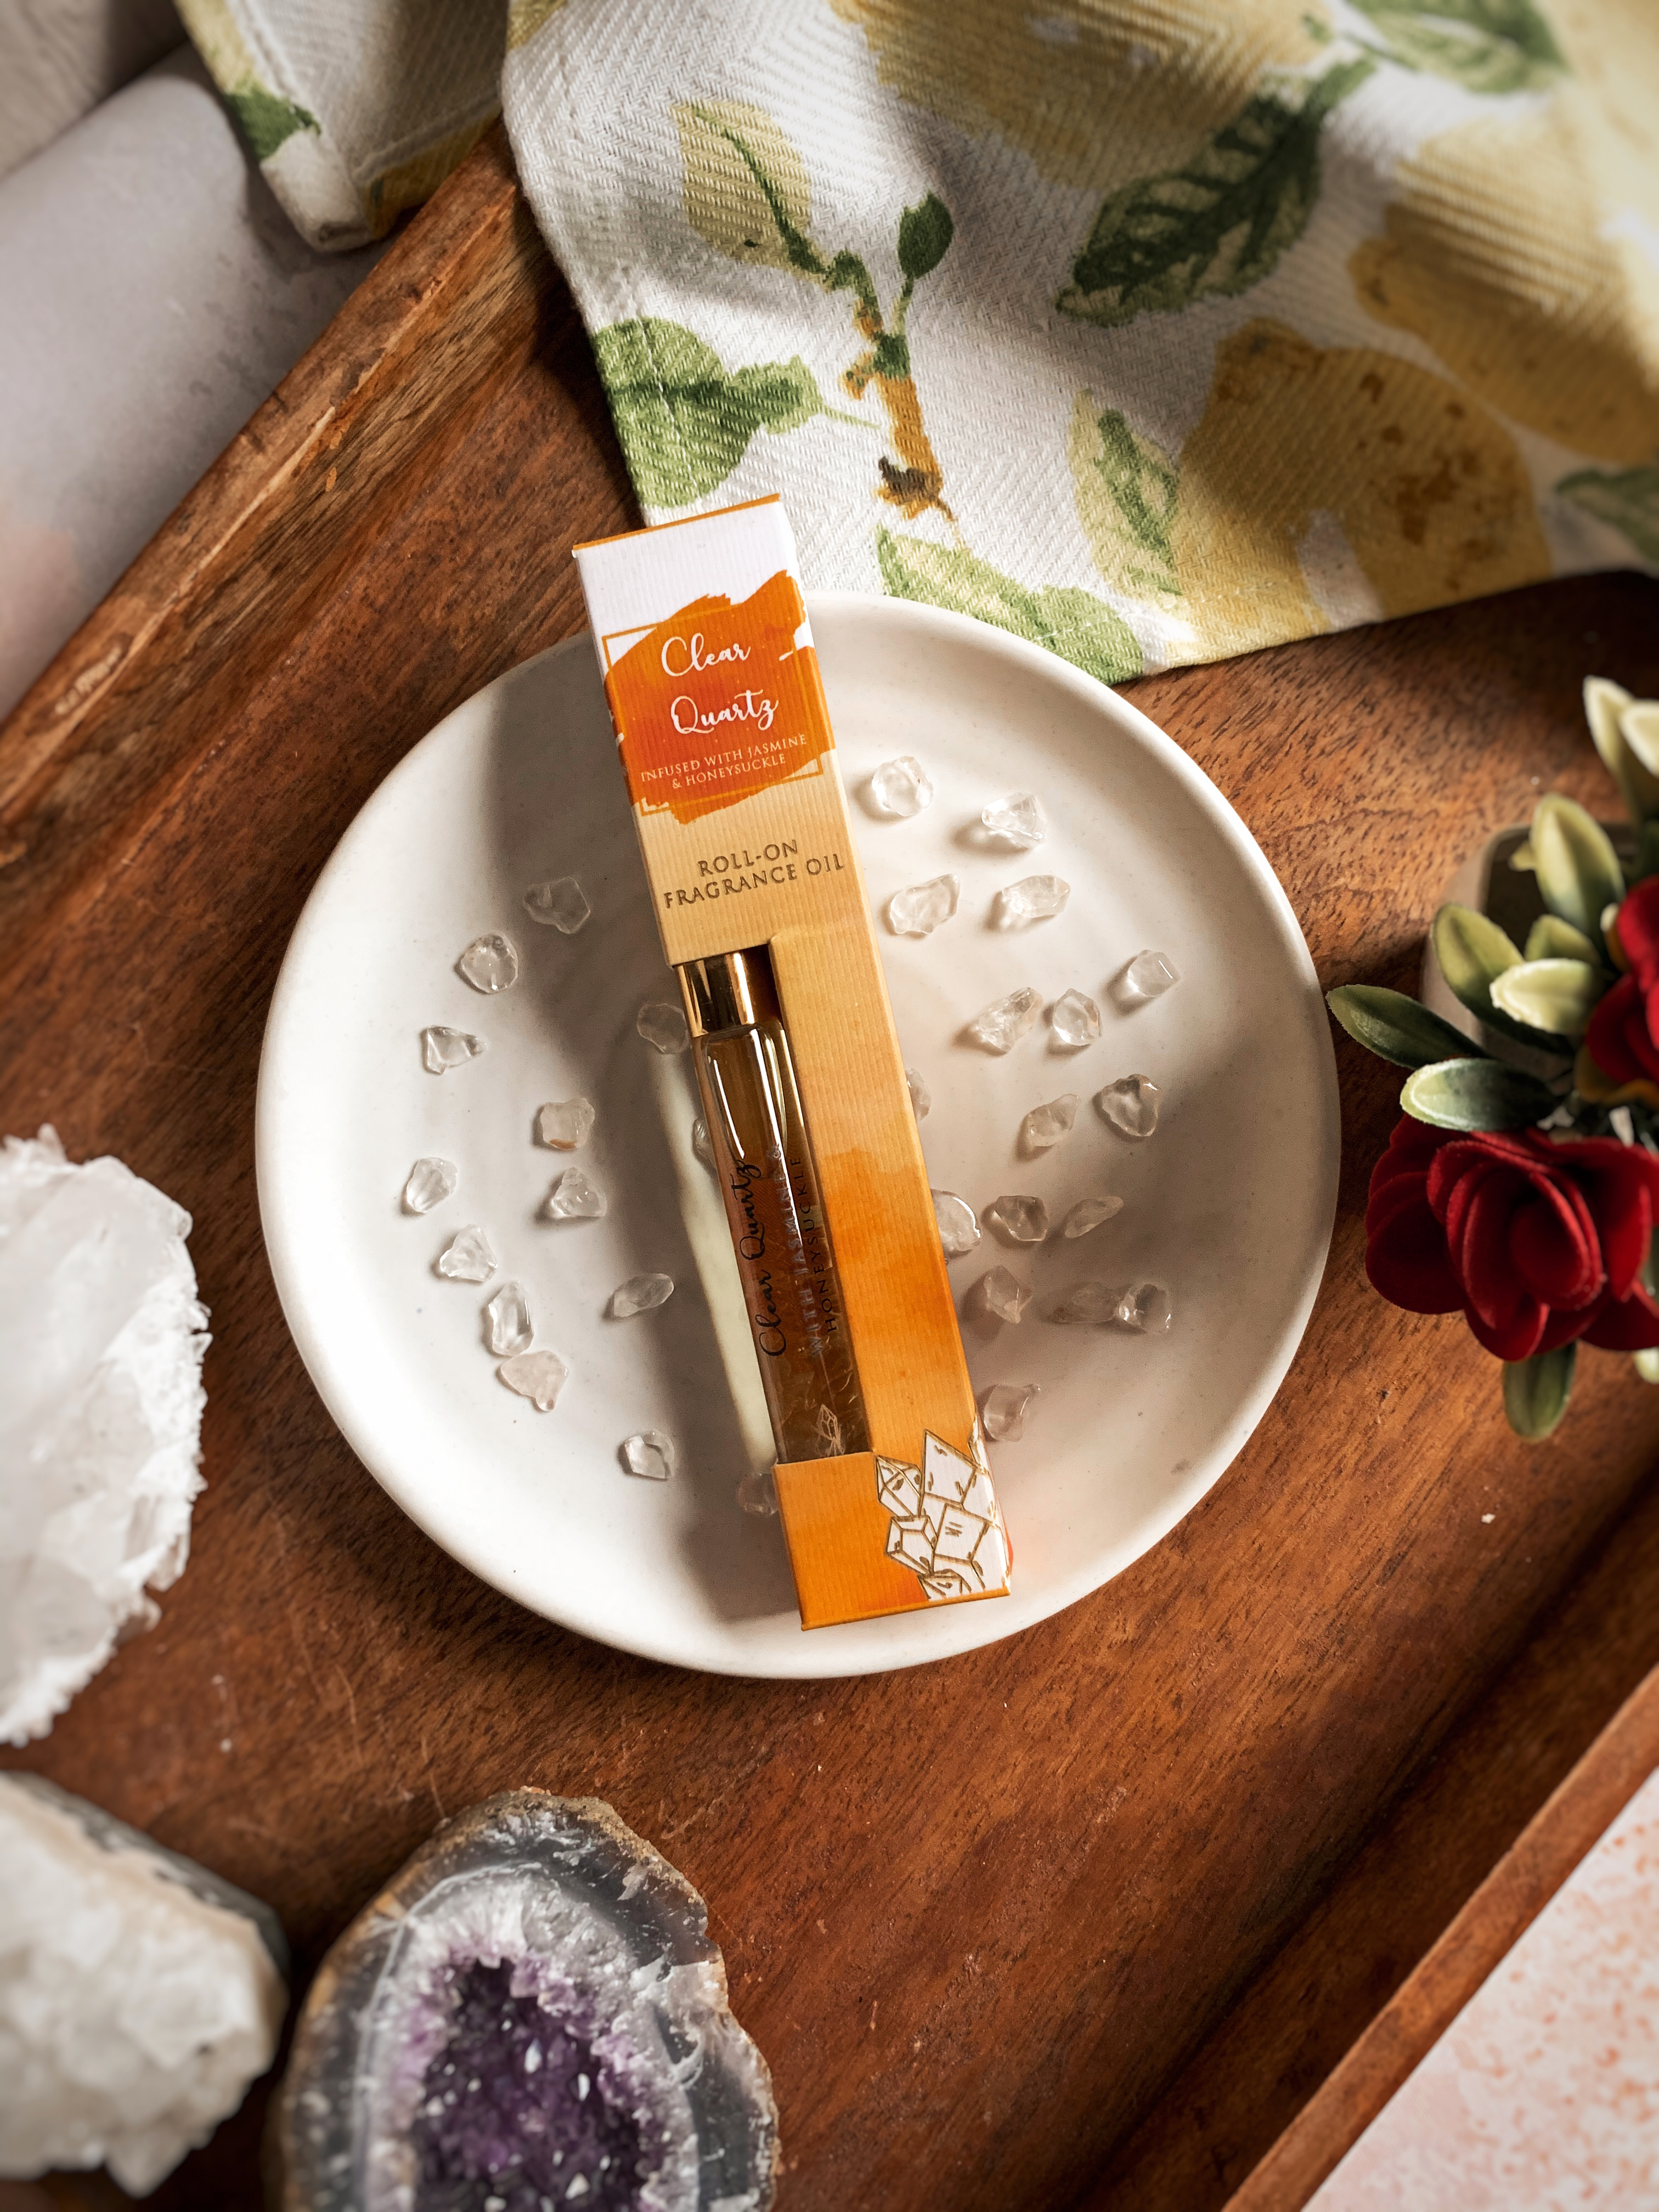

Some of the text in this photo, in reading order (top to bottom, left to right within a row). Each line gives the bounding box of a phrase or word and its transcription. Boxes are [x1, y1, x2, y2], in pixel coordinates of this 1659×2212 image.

[662, 633, 751, 676] Clear
[670, 689, 778, 734] Quartz
[641, 734, 807, 782] INFUSED WITH JASMINE
[672, 754, 786, 789] & HONEYSUCKLE
[664, 853, 844, 909] FRAGRANCE OIL
[698, 839, 799, 876] ROLL-ON
[731, 1159, 786, 1356] Clear Quartz
[790, 1156, 837, 1332] HONEYSUCKLE
[798, 1289, 823, 1357] WITH
